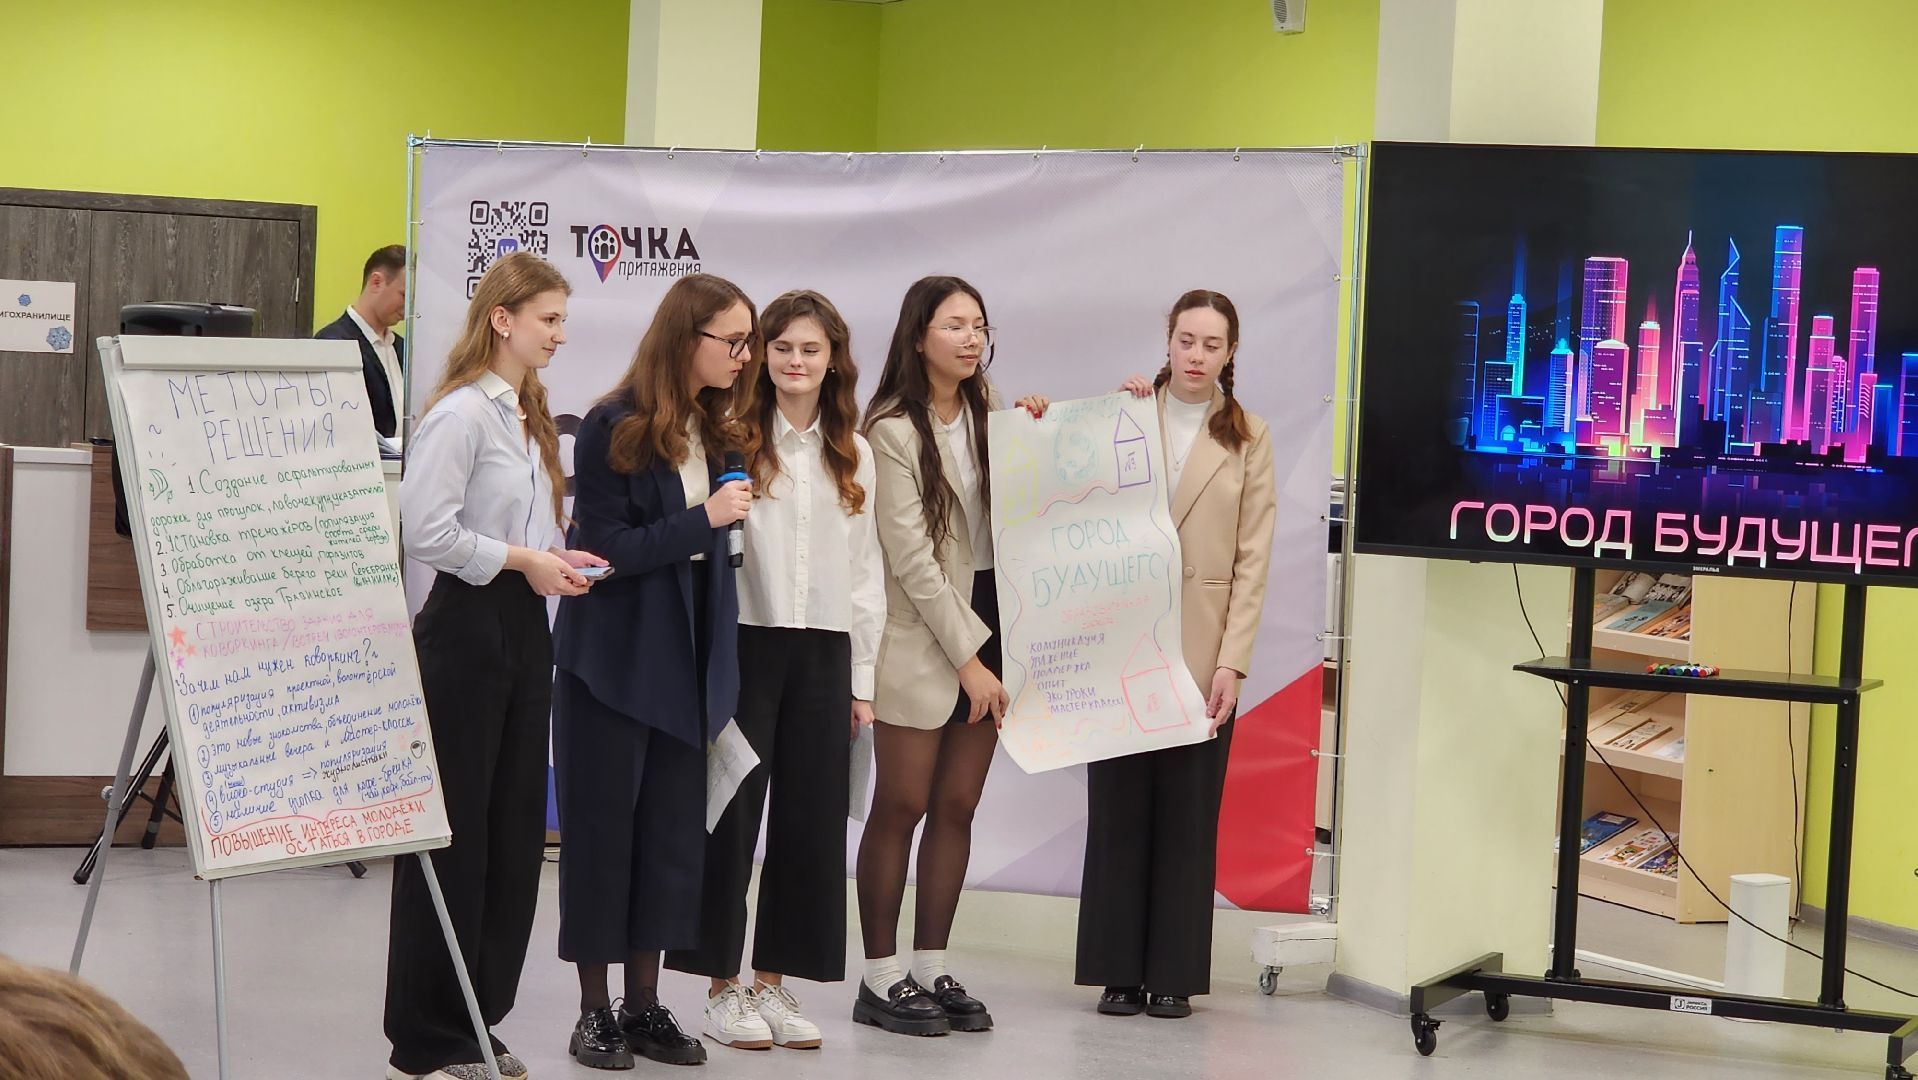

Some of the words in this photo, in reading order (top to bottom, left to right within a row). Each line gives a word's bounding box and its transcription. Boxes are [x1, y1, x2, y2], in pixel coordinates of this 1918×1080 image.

[618, 261, 701, 280] притяжения
[168, 371, 333, 419] МЕТОДЫ
[203, 412, 335, 464] РЕШЕНИЯ
[199, 468, 267, 498] Создание
[196, 511, 213, 529] для
[1051, 518, 1131, 552] ГОРОД
[1449, 500, 1634, 560] ГОРОД
[172, 553, 237, 578] Обработка
[246, 549, 267, 561] от
[324, 570, 348, 585] реки
[1032, 552, 1163, 608] БУДУЩЕГО
[179, 672, 220, 695] Зачем
[225, 667, 251, 685] нам
[257, 658, 295, 676] нужен
[333, 783, 349, 804] для
[210, 823, 297, 858] ПОВЫШЕНИЕ
[300, 816, 357, 838] ИНТЕРЕСА
[285, 834, 351, 855] ОСТАТЬСЯ
[357, 829, 366, 844] В
[367, 818, 414, 842] ГОРОДЕ
